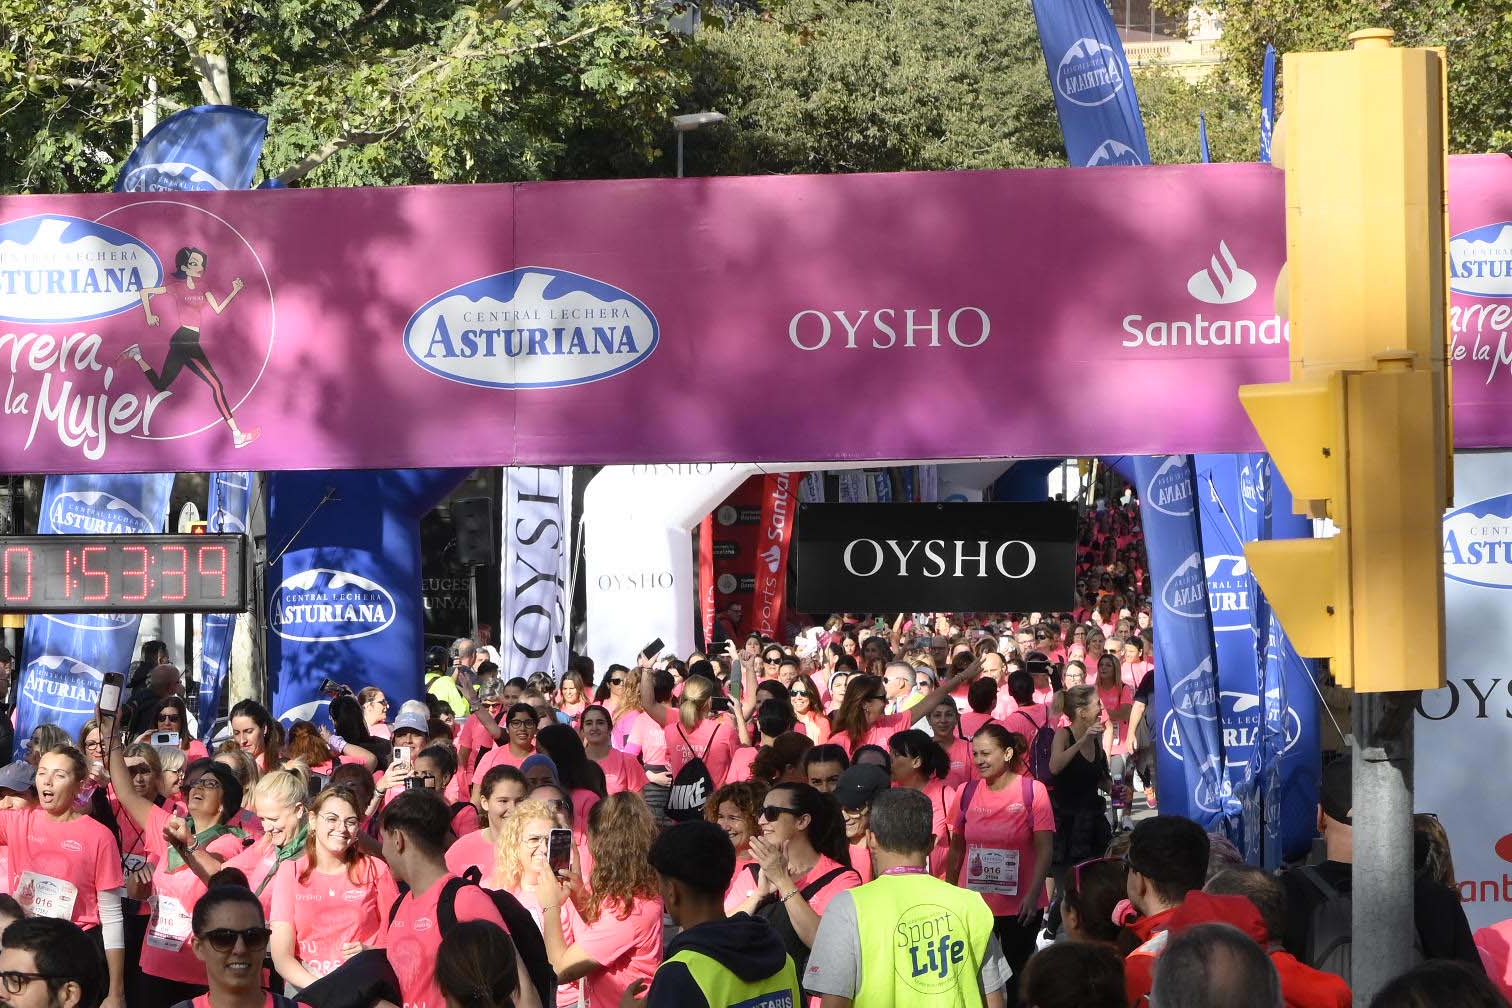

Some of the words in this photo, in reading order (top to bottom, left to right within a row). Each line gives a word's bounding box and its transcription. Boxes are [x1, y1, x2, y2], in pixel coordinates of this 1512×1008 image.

[463, 309, 541, 322] CENTRAL
[550, 307, 631, 320] LECHERA
[788, 306, 992, 351] OYSHO
[423, 314, 640, 358] ASTURIANA
[4, 375, 29, 416] la
[23, 366, 173, 461] Mujer
[1470, 526, 1512, 536] CENT
[843, 537, 1037, 579] OYSHO
[598, 570, 674, 591] OYSHO
[273, 597, 387, 625] ASTURIANA
[286, 593, 328, 603] CENTRAL
[759, 577, 777, 638] ports
[668, 776, 707, 810] NIKE
[983, 866, 1001, 874] 016
[35, 896, 53, 908] 016
[1459, 873, 1512, 903] ant
[897, 911, 954, 948] Sport
[909, 934, 965, 978] Life
